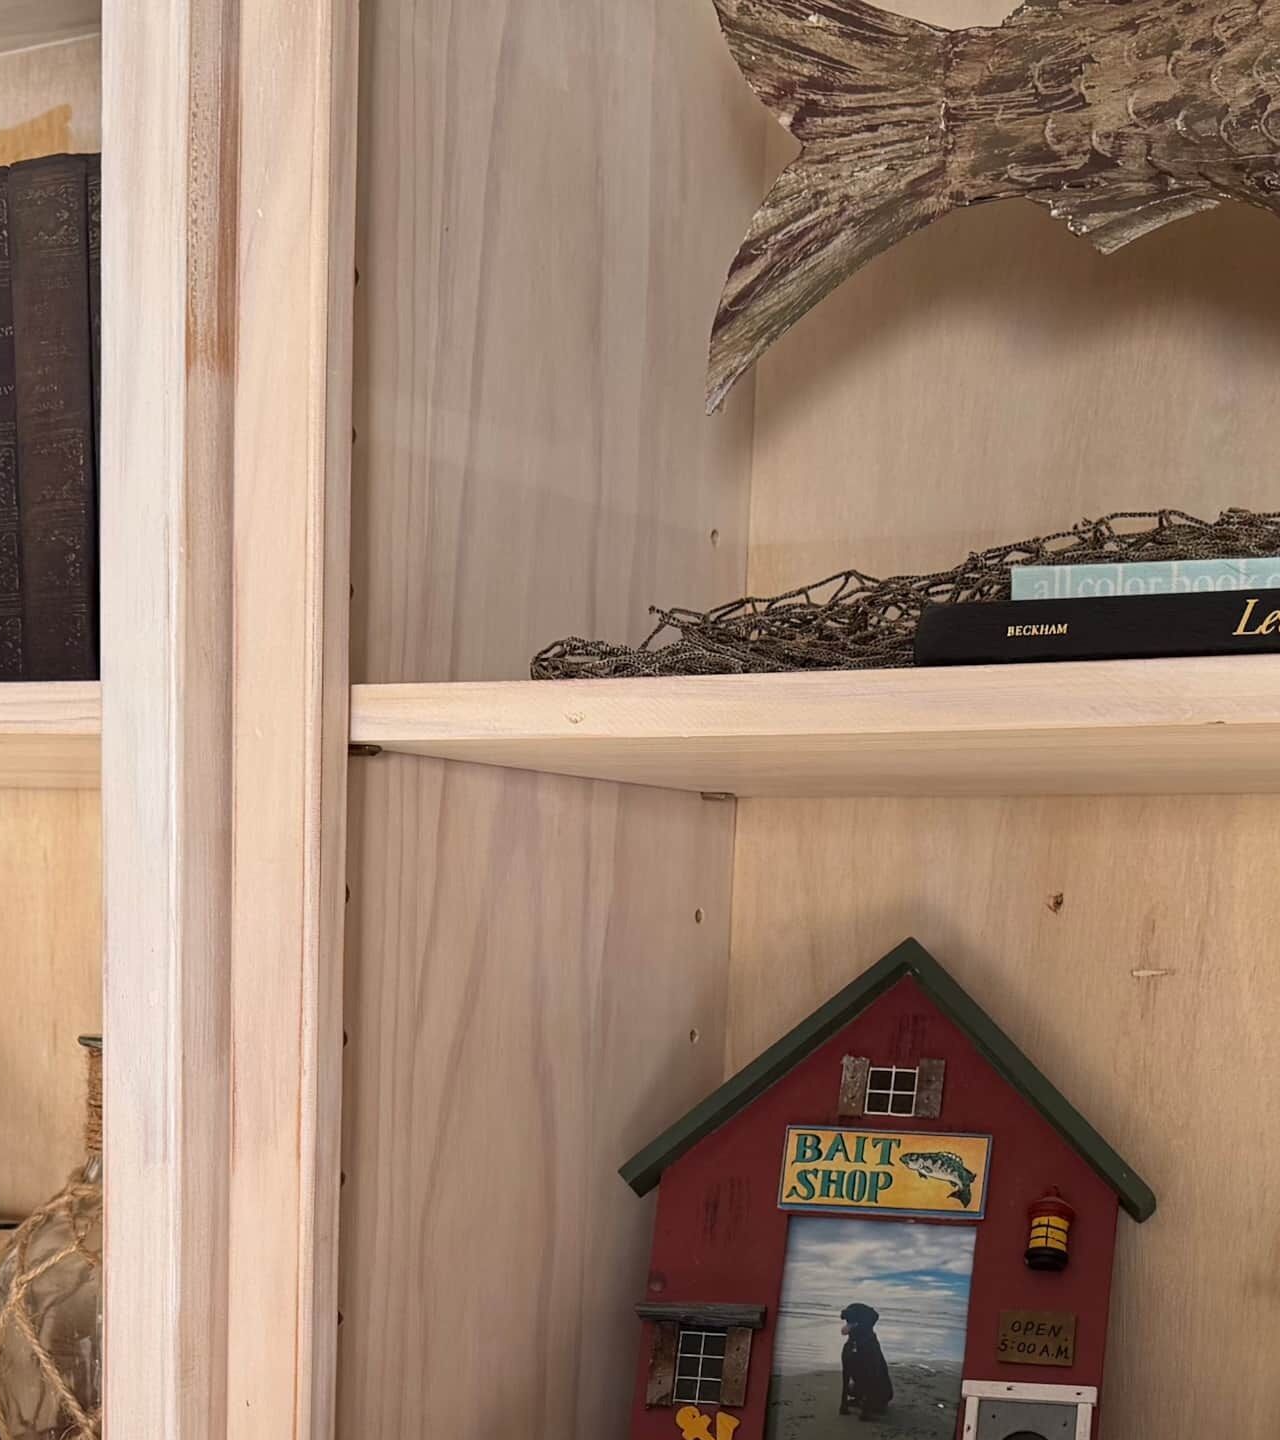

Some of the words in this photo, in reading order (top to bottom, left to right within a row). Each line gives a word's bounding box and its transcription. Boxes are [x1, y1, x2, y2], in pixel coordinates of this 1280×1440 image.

[1033, 567, 1071, 600] all
[1077, 566, 1163, 598] color
[1174, 558, 1256, 596] book
[1006, 622, 1069, 638] BECKHAM
[790, 1132, 902, 1167] BAIT
[785, 1167, 894, 1204] SHOP
[1010, 1320, 1063, 1337] OPEN
[997, 1338, 1036, 1354] 5:00
